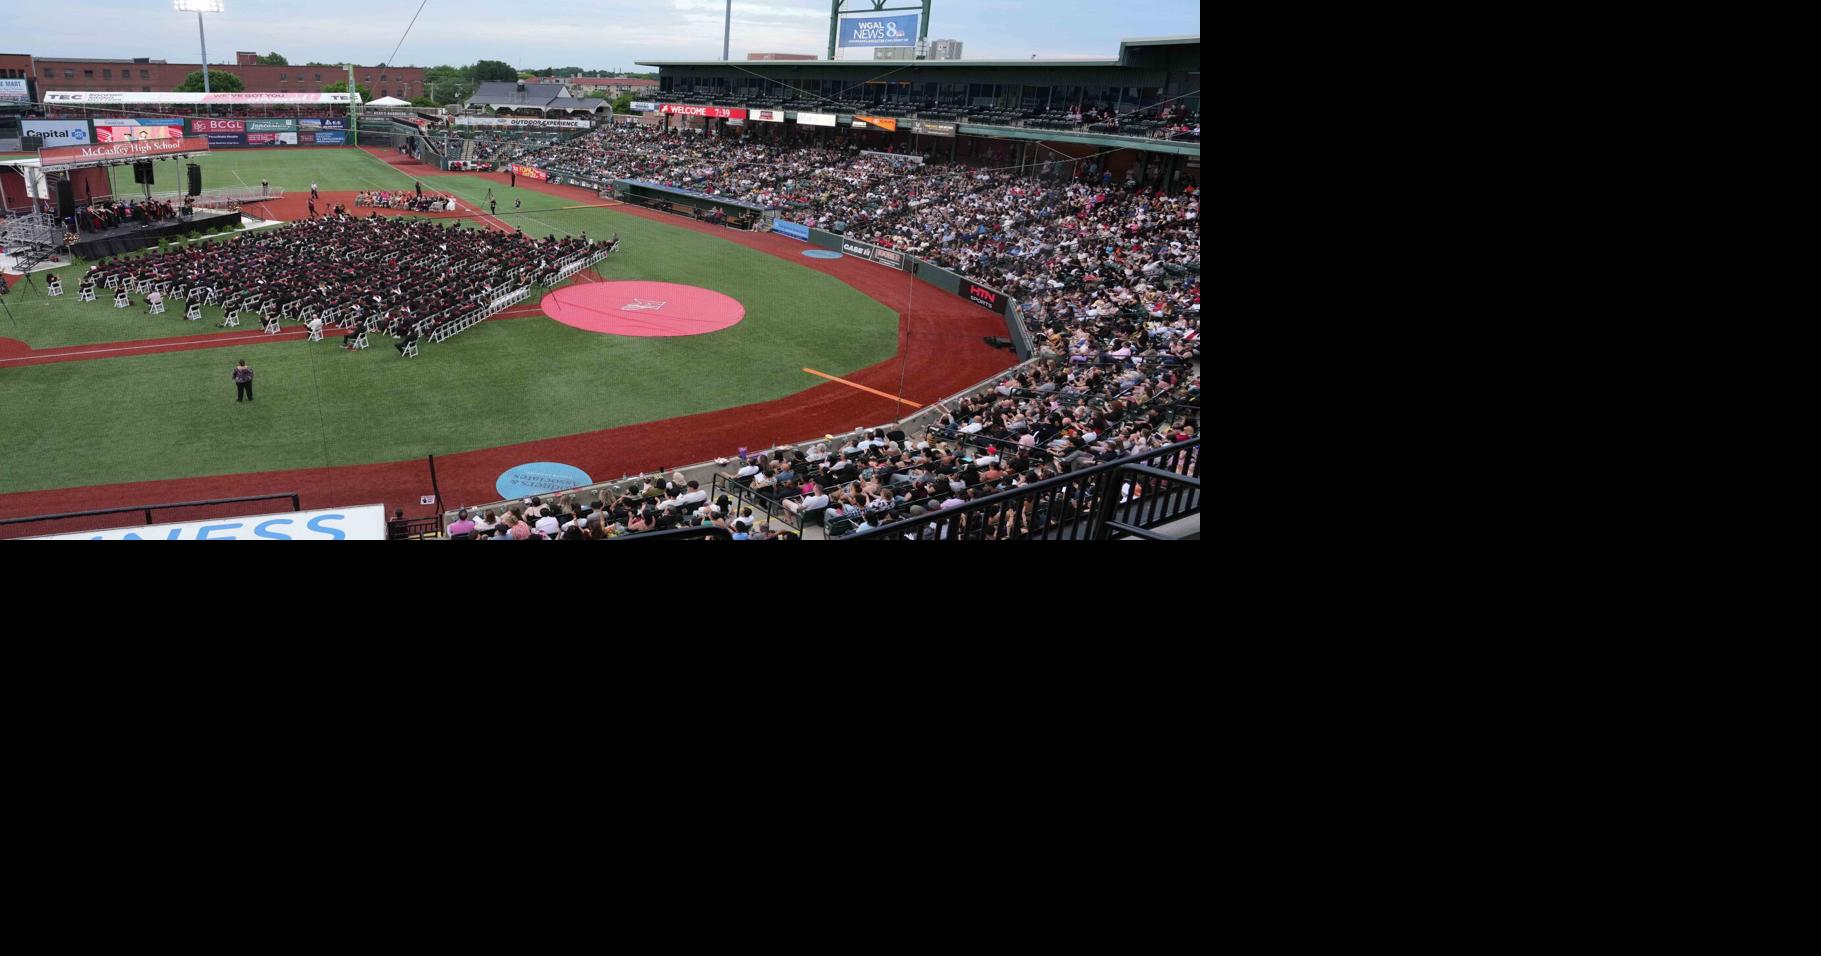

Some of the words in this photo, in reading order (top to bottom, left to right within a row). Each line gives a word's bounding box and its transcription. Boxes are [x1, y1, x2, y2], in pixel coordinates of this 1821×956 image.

[854, 29, 884, 39] NEWS
[886, 21, 897, 38] 8
[670, 105, 707, 116] WELCOME
[714, 108, 731, 117] 7:39
[210, 120, 243, 129] BCGL
[26, 129, 69, 139] Capital
[82, 143, 129, 156] McCaskey
[131, 143, 152, 153] High
[153, 140, 180, 150] School
[843, 243, 864, 254] CASE
[970, 295, 993, 309] SPORTS
